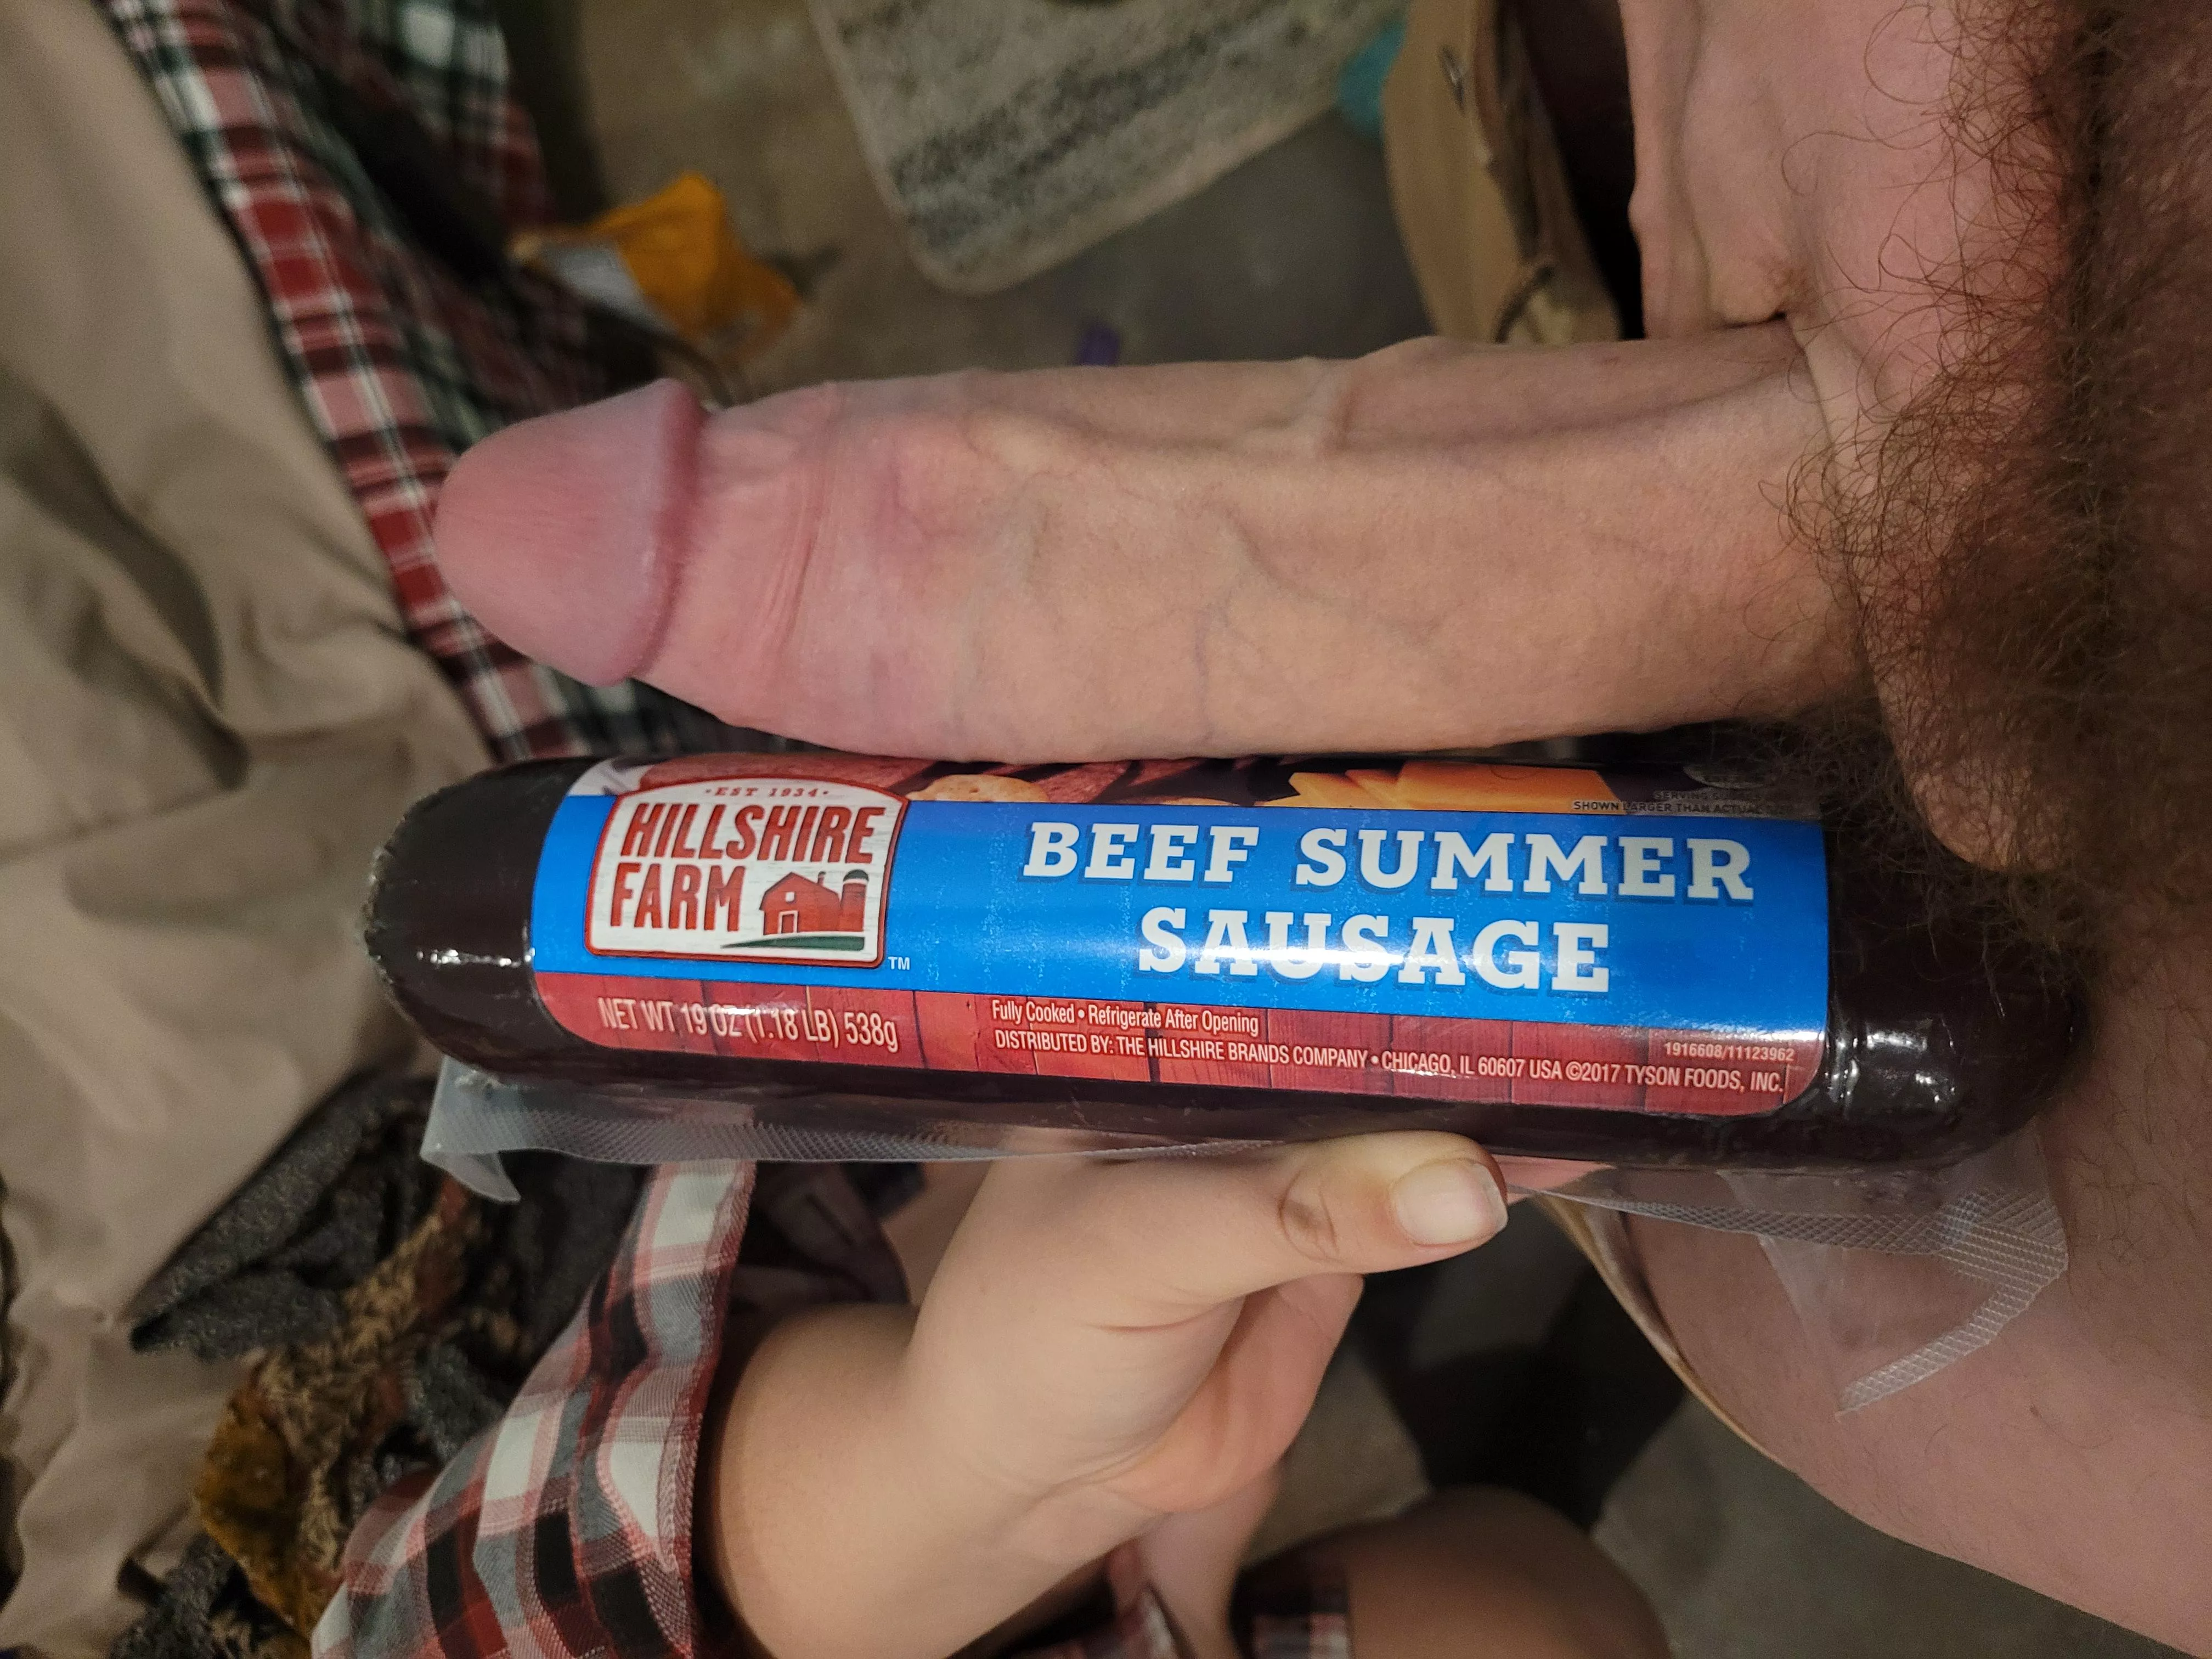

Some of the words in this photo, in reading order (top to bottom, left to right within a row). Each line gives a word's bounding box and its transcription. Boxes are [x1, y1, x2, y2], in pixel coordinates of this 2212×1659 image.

[715, 787, 758, 797] EST
[769, 787, 819, 797] 1934
[1573, 801, 1619, 811] SHOWN
[1622, 802, 1672, 812] LARGER
[620, 803, 885, 864] HILLSHIRE
[1023, 822, 1260, 883] BEEF
[1295, 827, 1754, 900] SUMMER
[610, 862, 746, 932] FARM
[888, 956, 911, 971] TM
[1139, 906, 1609, 993] SAUSAGE
[597, 997, 637, 1030] NET
[640, 1000, 675, 1034] WT
[681, 1003, 707, 1036] 19
[711, 1006, 744, 1038] OZ
[746, 1008, 798, 1042] (1.18
[805, 1008, 840, 1048] LB)
[844, 1012, 899, 1053] 538g
[992, 999, 1023, 1025] Fully
[1025, 1001, 1075, 1024] Cooked
[1088, 1005, 1161, 1030] Refrigerate
[1165, 1008, 1199, 1030] After
[1201, 1011, 1259, 1037] Opening
[995, 1029, 1087, 1052] DISTRIBUTED
[1091, 1035, 1114, 1054] BY:
[1116, 1036, 1145, 1056] THE
[1148, 1037, 1225, 1060] HILLSHIRE
[1228, 1042, 1289, 1065] BRANDS
[1293, 1046, 1368, 1069] COMPANY
[1381, 1050, 1455, 1076] CHICAGO,
[1459, 1054, 1475, 1074] IL
[1478, 1056, 1525, 1077] 60607
[1528, 1059, 1561, 1080] USA
[1624, 1064, 1681, 1087] TYSON
[1683, 1068, 1746, 1093] FOODS,
[1750, 1071, 1784, 1093] INC.
[1664, 1041, 1796, 1062] 1916608/11123962
